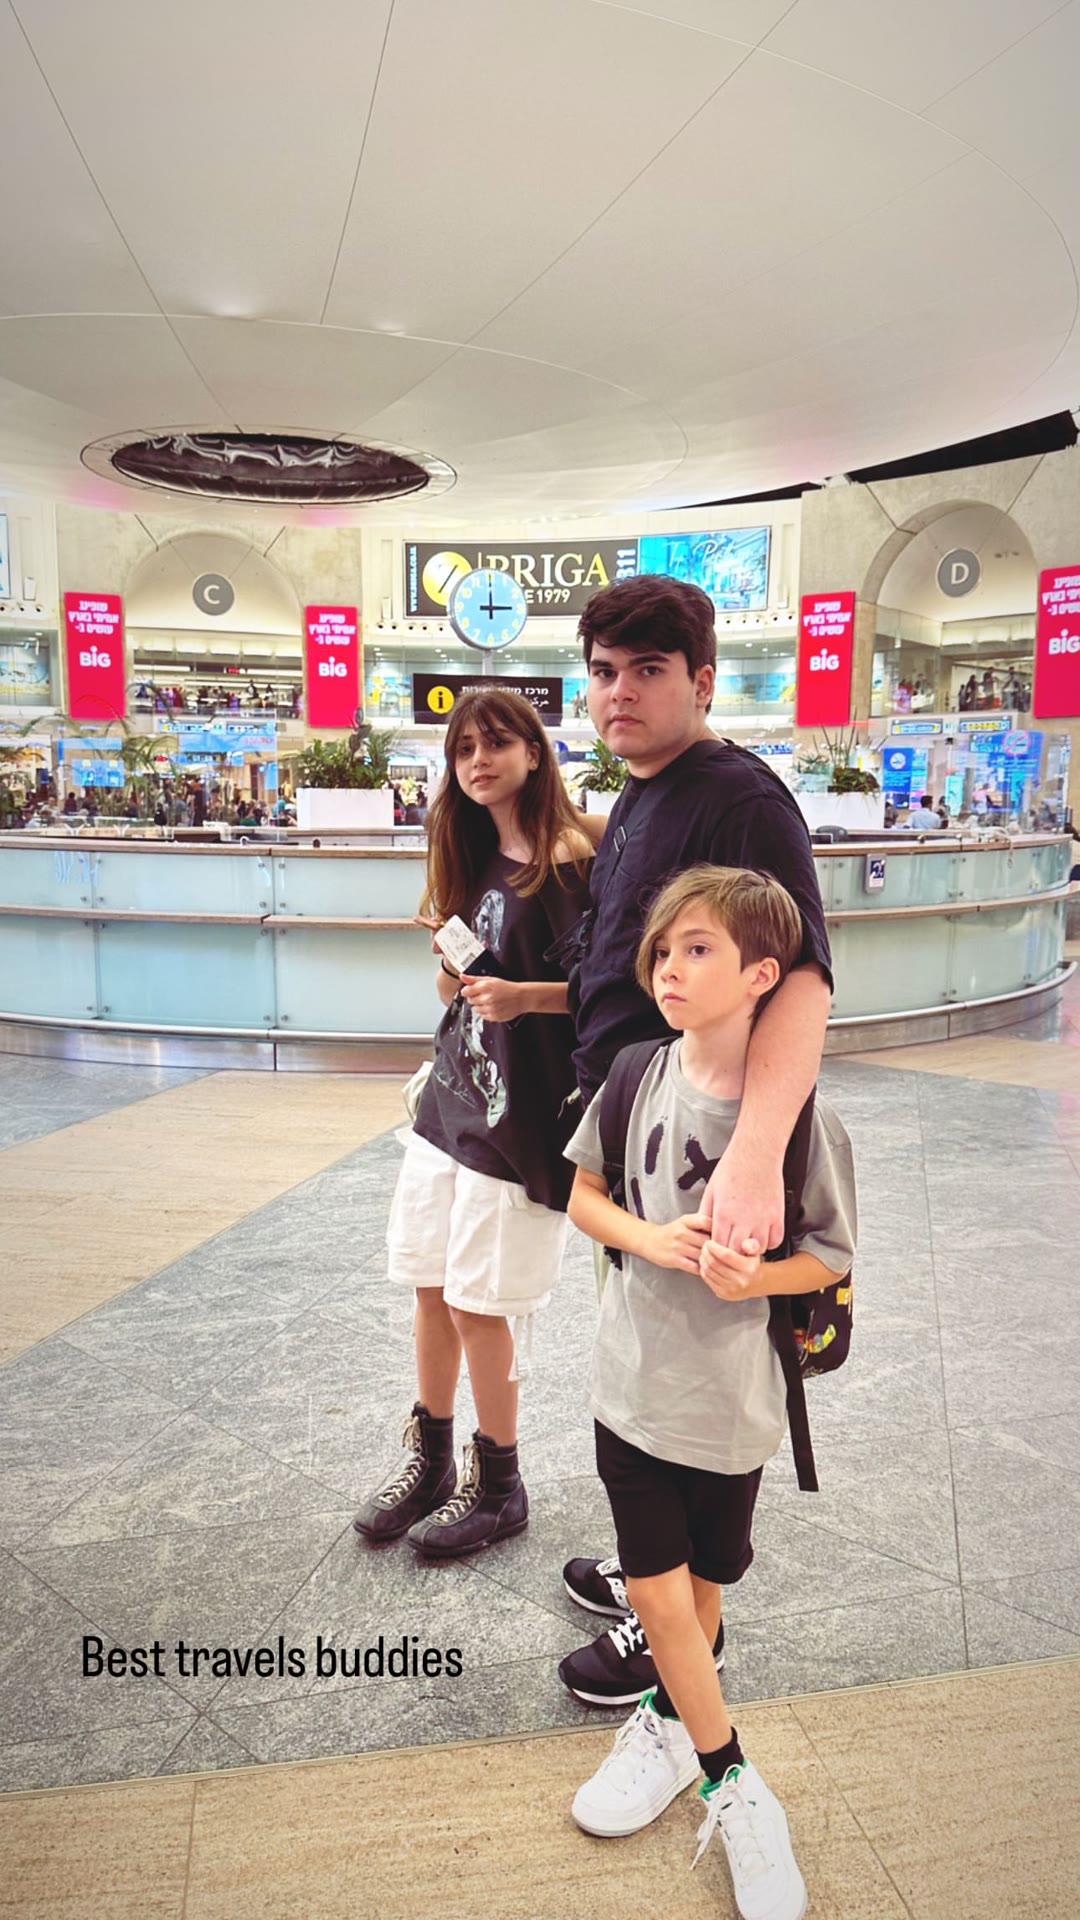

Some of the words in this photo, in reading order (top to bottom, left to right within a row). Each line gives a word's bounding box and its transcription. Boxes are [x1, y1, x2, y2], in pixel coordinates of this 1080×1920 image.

[951, 562, 969, 585] D
[203, 584, 220, 605] C
[537, 589, 571, 603] 1979
[525, 687, 549, 695] מרכז
